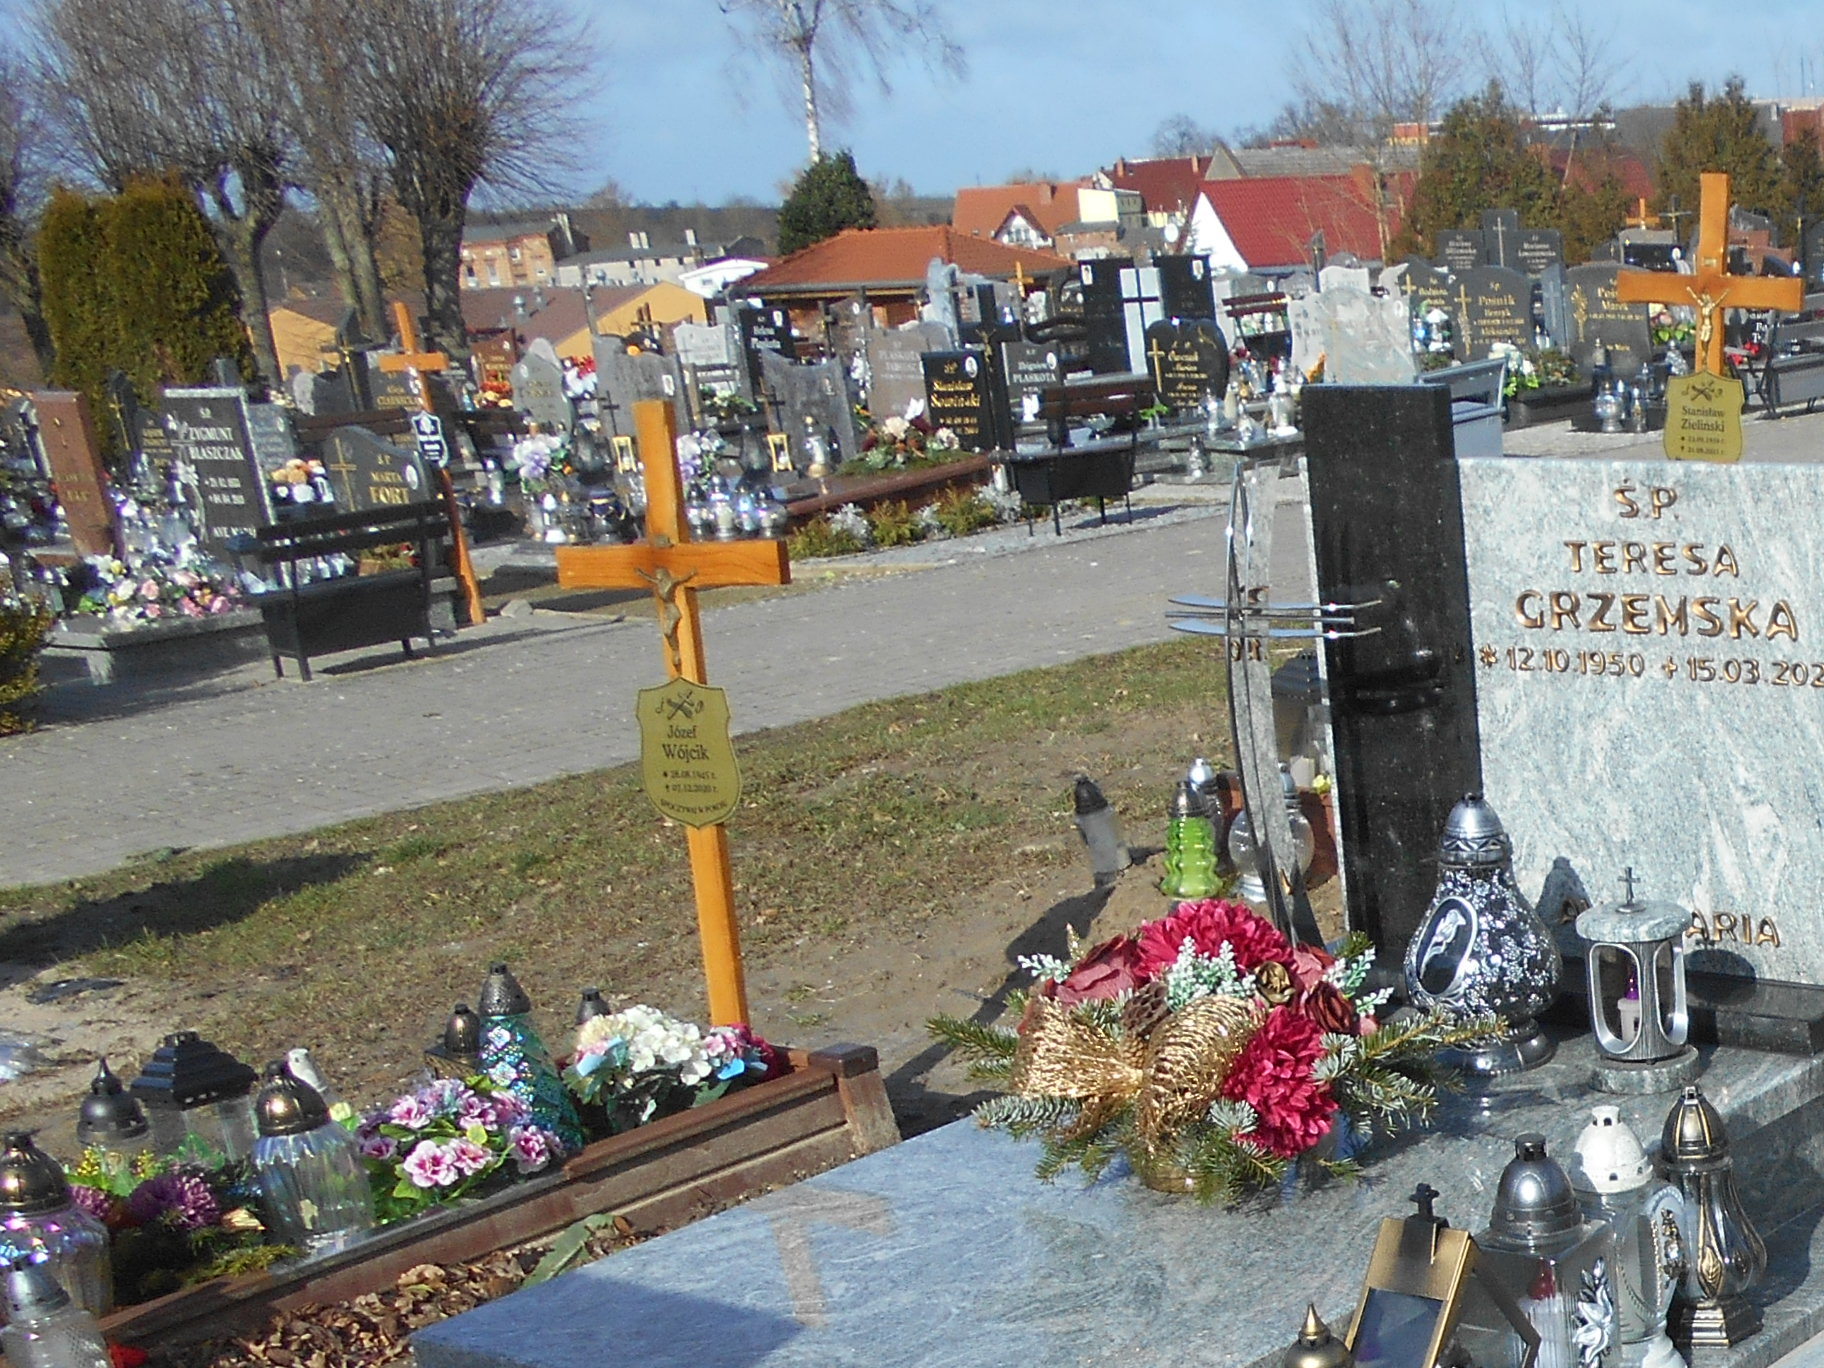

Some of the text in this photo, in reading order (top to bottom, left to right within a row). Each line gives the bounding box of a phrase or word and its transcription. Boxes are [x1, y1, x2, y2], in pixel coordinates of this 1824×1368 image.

[369, 486, 410, 504] FORT
[1564, 541, 1740, 577] TERESA
[1514, 590, 1799, 642] GRZEMSKA
[1507, 647, 1645, 678] 12.10.1950
[667, 725, 697, 739] Józef
[662, 744, 709, 763] Wójcik
[1686, 911, 1781, 948] ARIA
